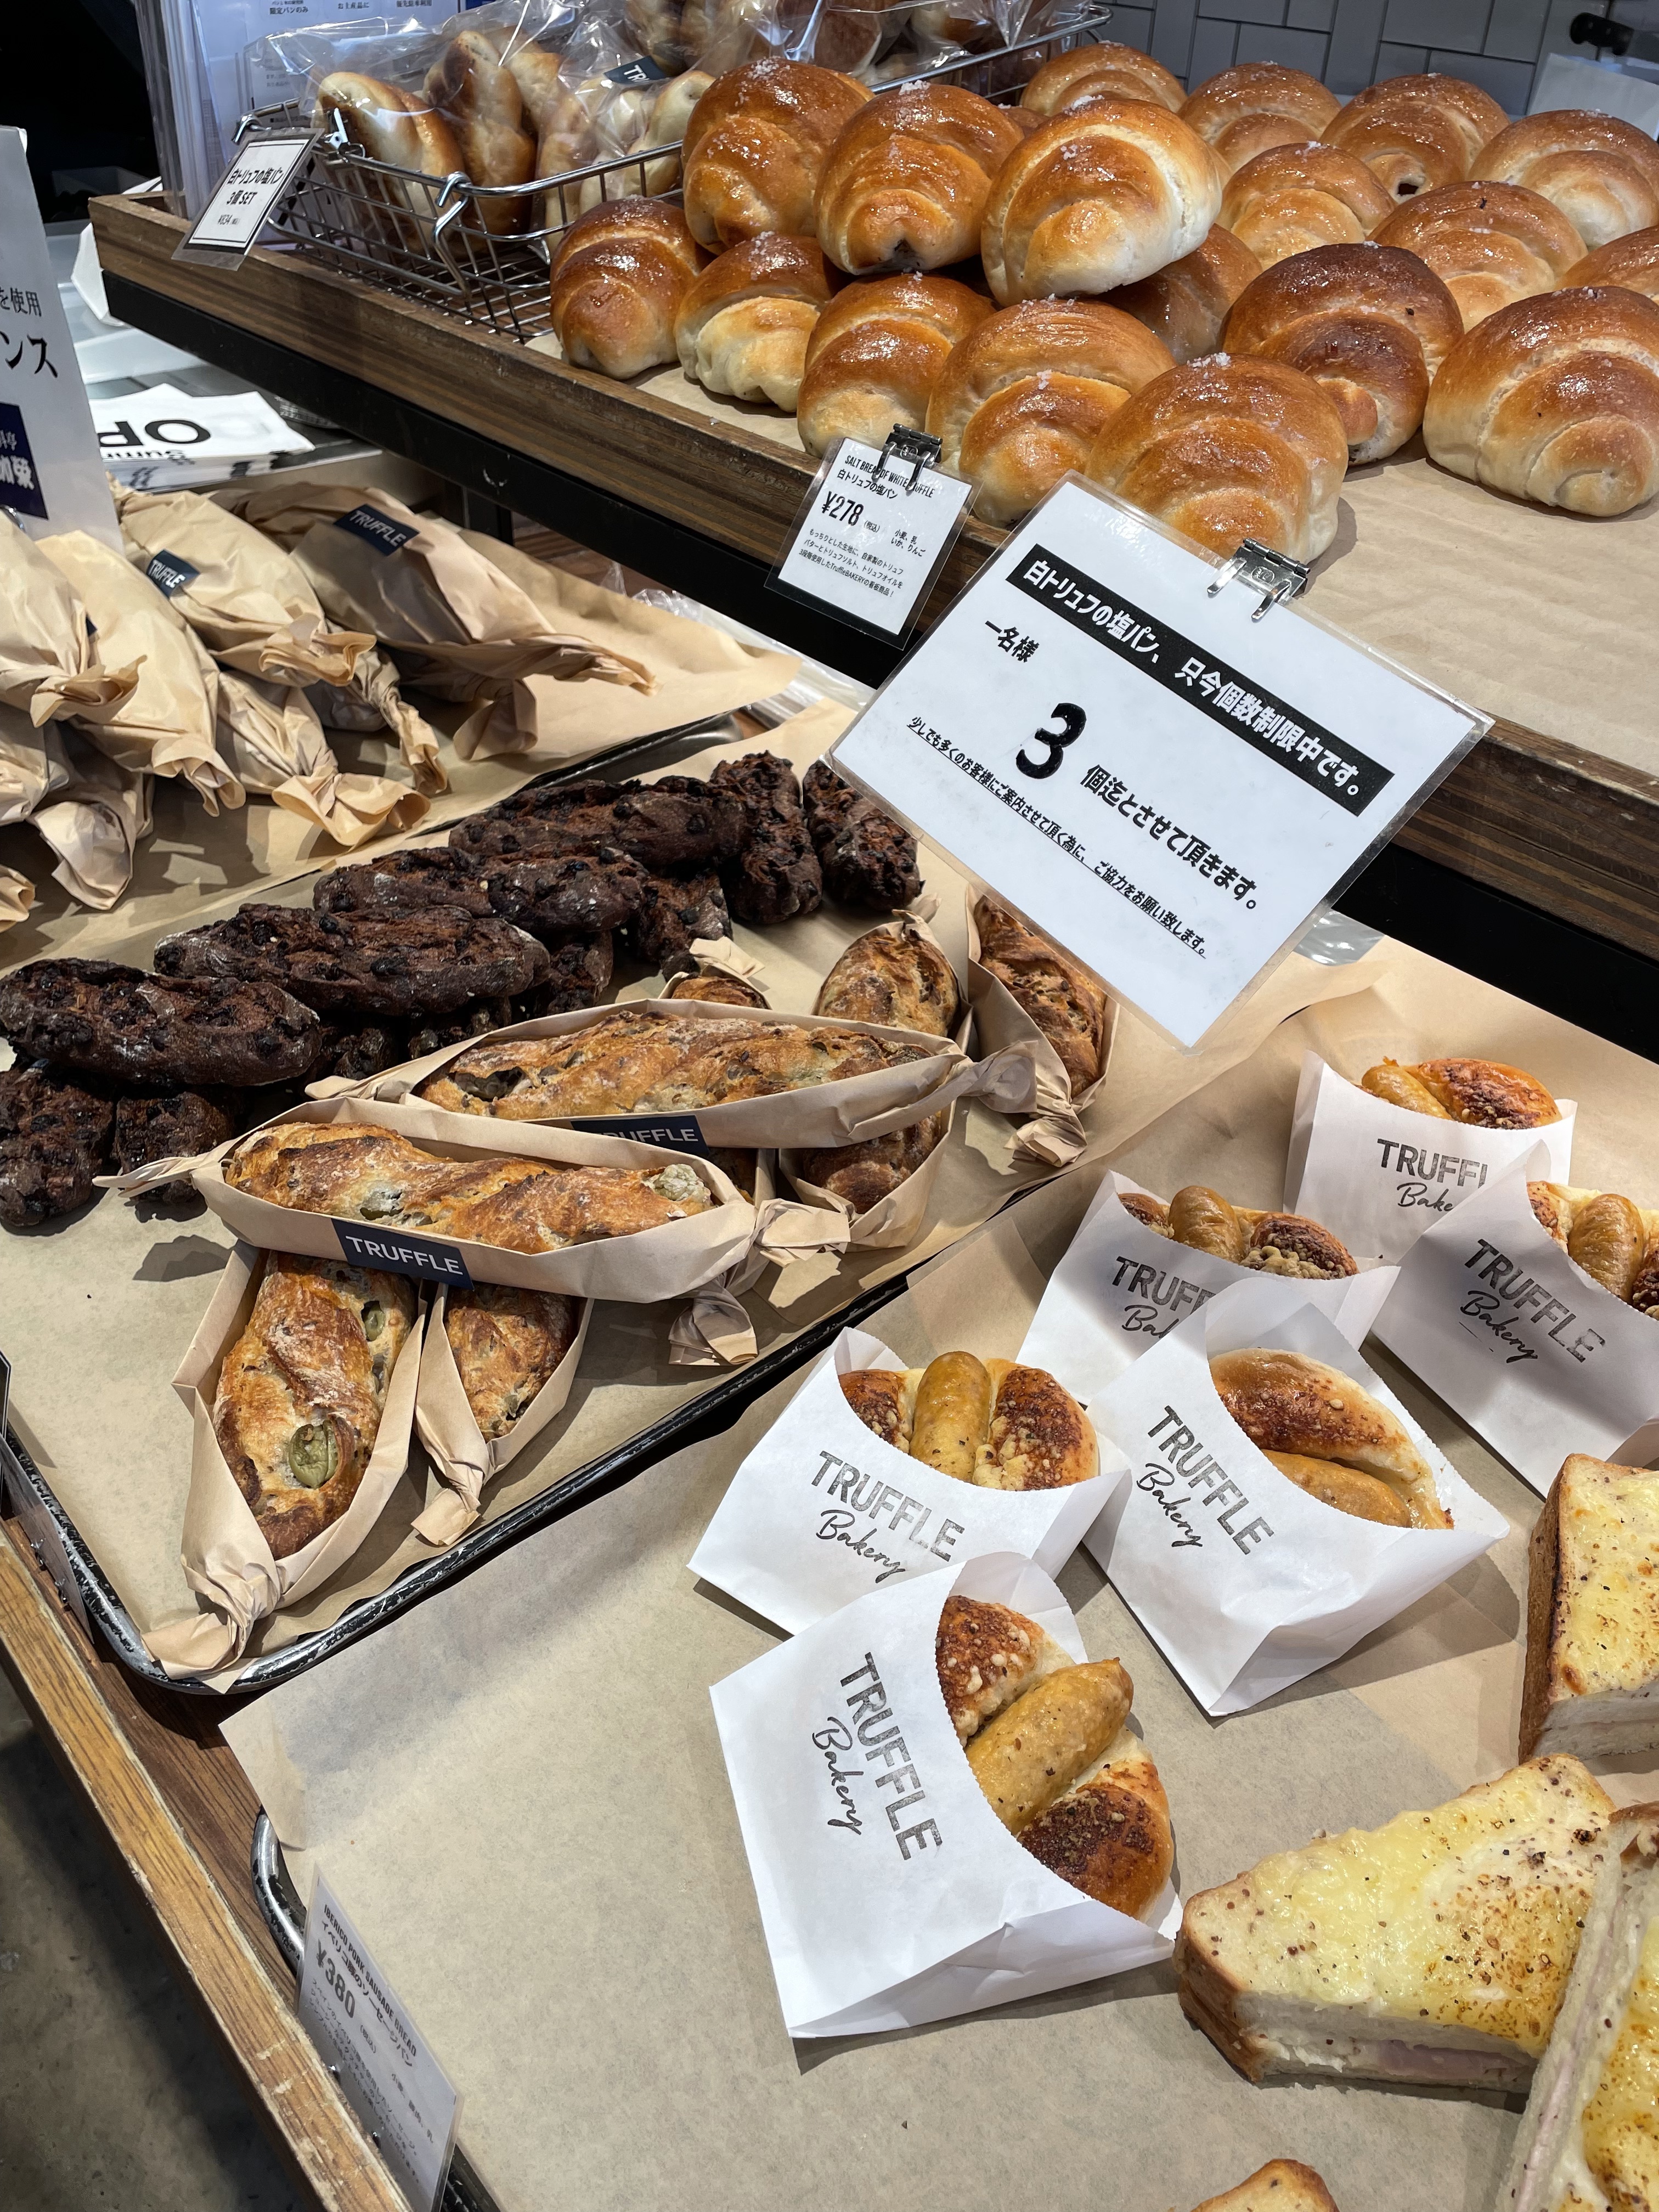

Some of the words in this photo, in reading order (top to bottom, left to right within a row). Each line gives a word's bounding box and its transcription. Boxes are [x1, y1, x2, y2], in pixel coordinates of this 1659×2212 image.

[227, 167, 284, 185] 白トリュフの塩パン
[837, 469, 898, 499] 白トリュフの塩パン
[845, 455, 862, 469] SALT
[860, 459, 879, 476] BREA
[879, 469, 890, 479] OF
[888, 472, 909, 488] WHITE
[348, 509, 407, 549] TRUFFLE
[821, 490, 864, 526] ¥278
[862, 520, 881, 533] (税込)
[149, 558, 187, 589] TRUFFLE
[985, 620, 1040, 663] 一名様
[1015, 702, 1087, 780] 3
[1080, 764, 1256, 910] 個迄とさせて頂きます。
[1397, 1182, 1453, 1212] Bake
[345, 1235, 464, 1276] TRUFFLE
[1111, 1256, 1216, 1315] TRUFF
[1460, 1290, 1538, 1364] Bakery
[1464, 1239, 1606, 1363] TRUFFLE
[811, 1450, 965, 1562] TRUFFLE
[1136, 1462, 1203, 1548] Bakery
[1147, 1405, 1275, 1555] TRUFFLE
[816, 1509, 906, 1584] Bakery
[811, 1717, 864, 1836] Bakery
[840, 1651, 943, 1861] TRUFFLE
[317, 1939, 356, 2019] ¥380
[324, 1903, 347, 1946] IBERICO
[348, 1942, 364, 1974] PORK
[365, 1970, 394, 2022] SAUSAGE
[394, 2016, 416, 2059] BREAD
